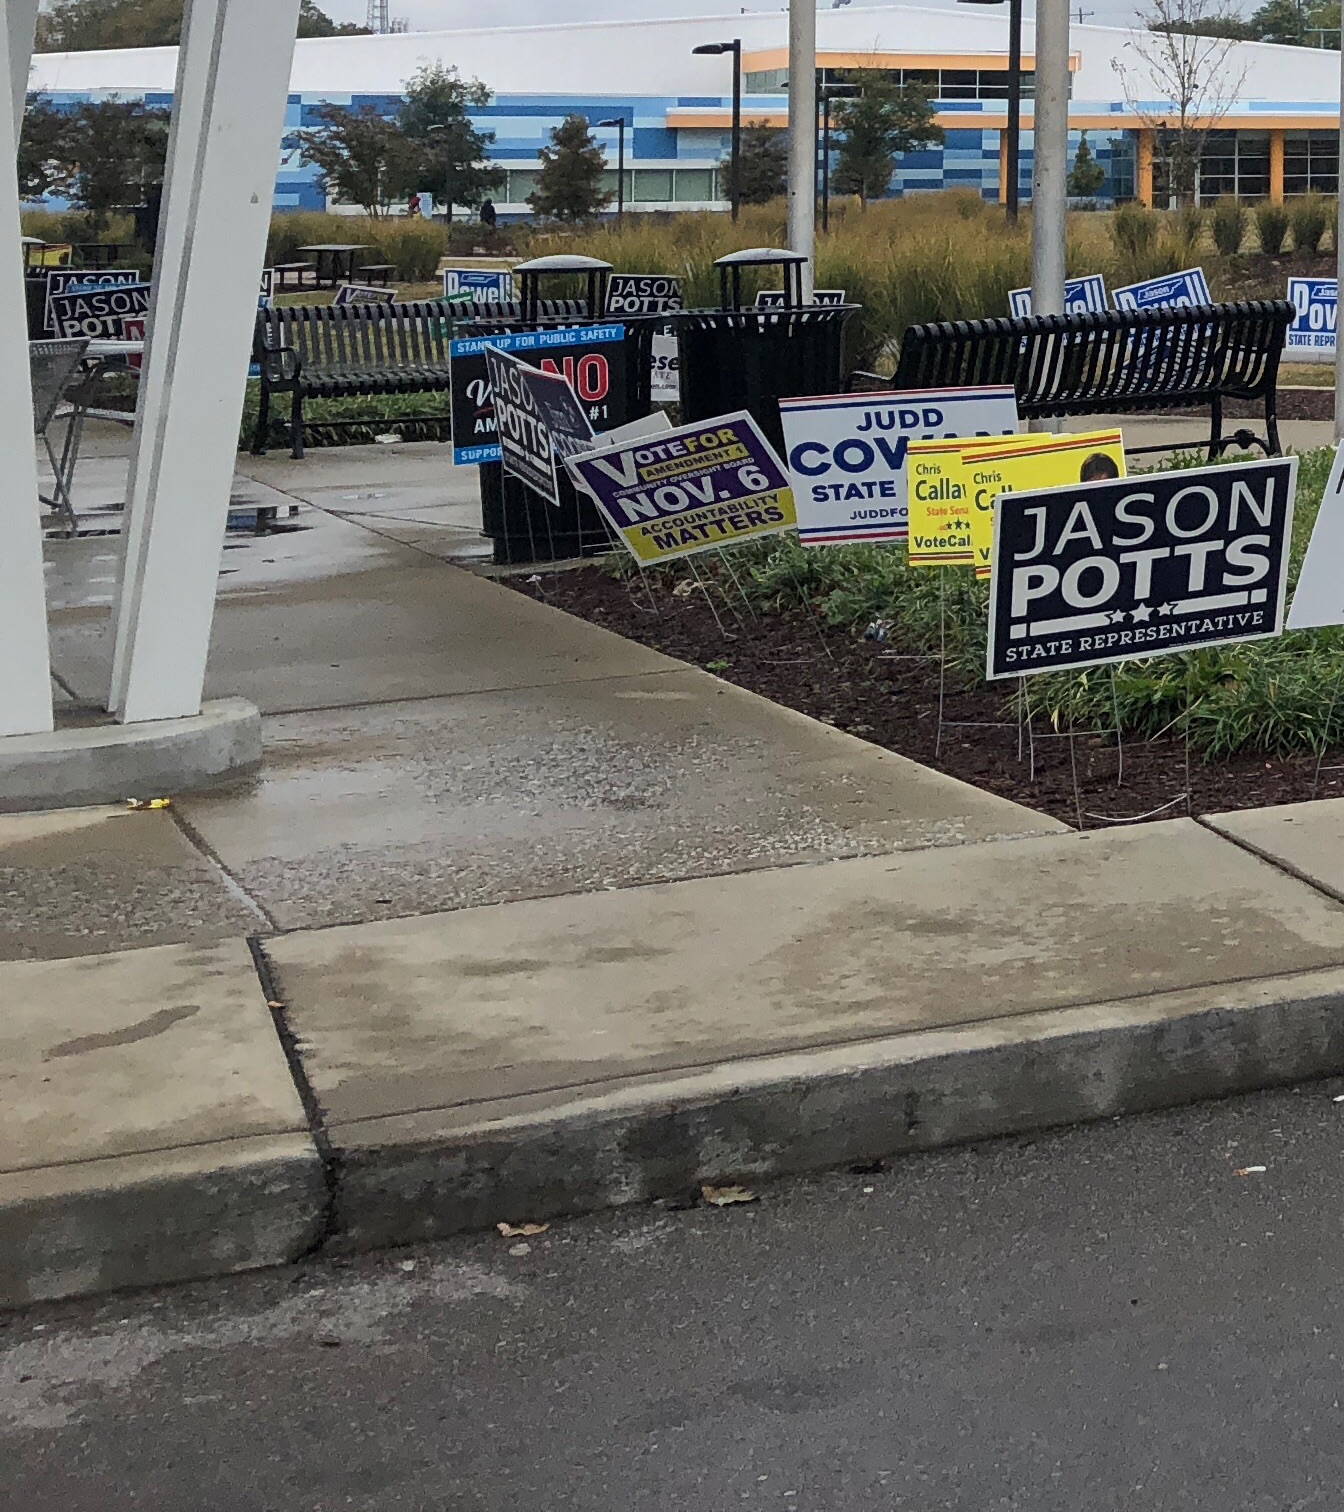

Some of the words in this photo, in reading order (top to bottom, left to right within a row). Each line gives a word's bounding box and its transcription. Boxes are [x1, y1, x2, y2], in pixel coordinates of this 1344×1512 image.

[610, 296, 681, 313] POTTS
[496, 338, 512, 349] UP
[515, 335, 535, 347] FOR
[539, 332, 576, 345] PUBLIC
[580, 327, 617, 341] SAFETY
[1288, 334, 1312, 347] STATE
[588, 404, 609, 421] #1
[856, 408, 944, 432] JUDD
[495, 397, 549, 459] POTTS
[460, 446, 503, 461] SUPPOR
[646, 450, 731, 478] AMENDMENT
[669, 465, 721, 483] OVERSIGHT
[723, 457, 755, 469] BOARD
[915, 463, 942, 476] Chris
[973, 470, 1002, 486] Chris
[617, 476, 731, 522] NOV.
[737, 465, 770, 491] 6
[812, 480, 897, 503] STATE
[640, 493, 779, 537] ACCOUNTABILITY
[849, 507, 908, 520] JUDDFO
[926, 506, 948, 516] State
[949, 506, 969, 516] Sena
[1014, 477, 1275, 561] JASON
[652, 505, 785, 550] MATTERS
[914, 534, 971, 549] VoteCal
[1010, 534, 1270, 618] POTTS
[1005, 639, 1072, 662] STATE
[1078, 611, 1264, 651] REPRESENTATIVE
